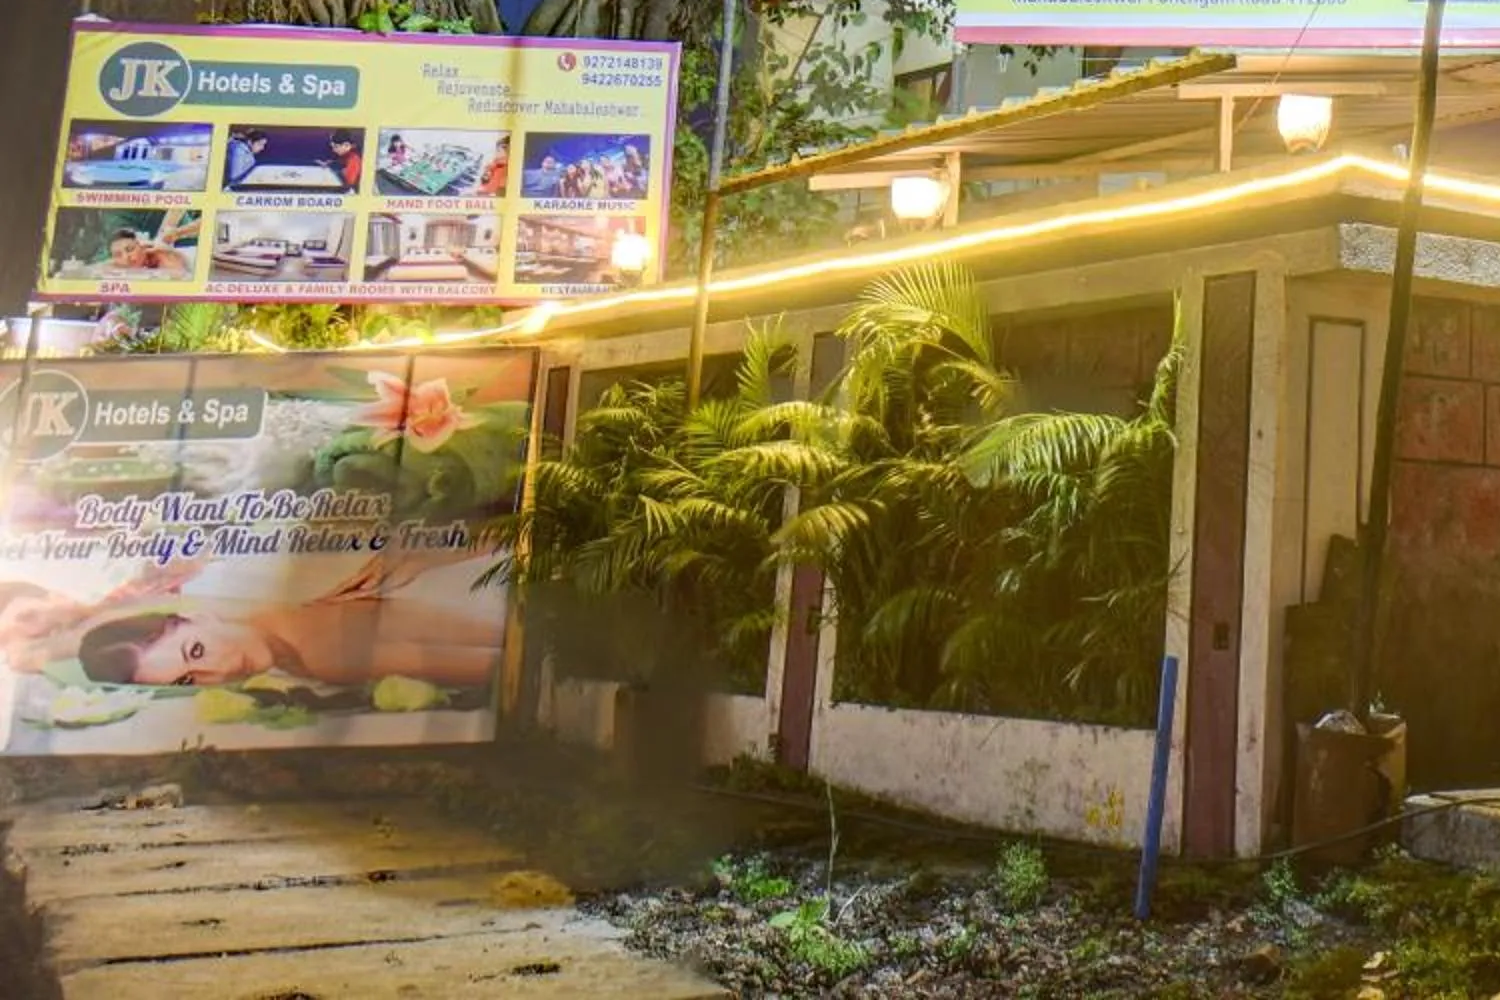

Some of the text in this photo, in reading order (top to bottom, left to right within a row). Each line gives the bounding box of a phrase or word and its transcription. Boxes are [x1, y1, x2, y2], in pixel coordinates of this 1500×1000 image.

[110, 57, 346, 101] JK Hotels & Spa
[76, 192, 192, 205] SWIMMING POOL
[296, 196, 343, 208] BOARD
[427, 199, 461, 210] FOOT
[464, 199, 497, 210] BALL
[533, 199, 593, 211] KARAOKE
[99, 281, 131, 293] SPA
[228, 283, 280, 295] DELUXE
[298, 284, 344, 296] FAMILY
[349, 284, 396, 296] ROOMS
[400, 284, 433, 296] WITH
[437, 284, 498, 296] BALCONY
[93, 400, 171, 426] Hotels
[177, 399, 195, 424] &
[202, 398, 249, 430] Spa
[78, 489, 392, 529] Body Want To Be Relax
[106, 530, 176, 565] Body
[181, 528, 204, 557] &
[211, 524, 281, 556] Mind
[287, 524, 364, 553] Relax
[399, 519, 468, 550] Fresh
